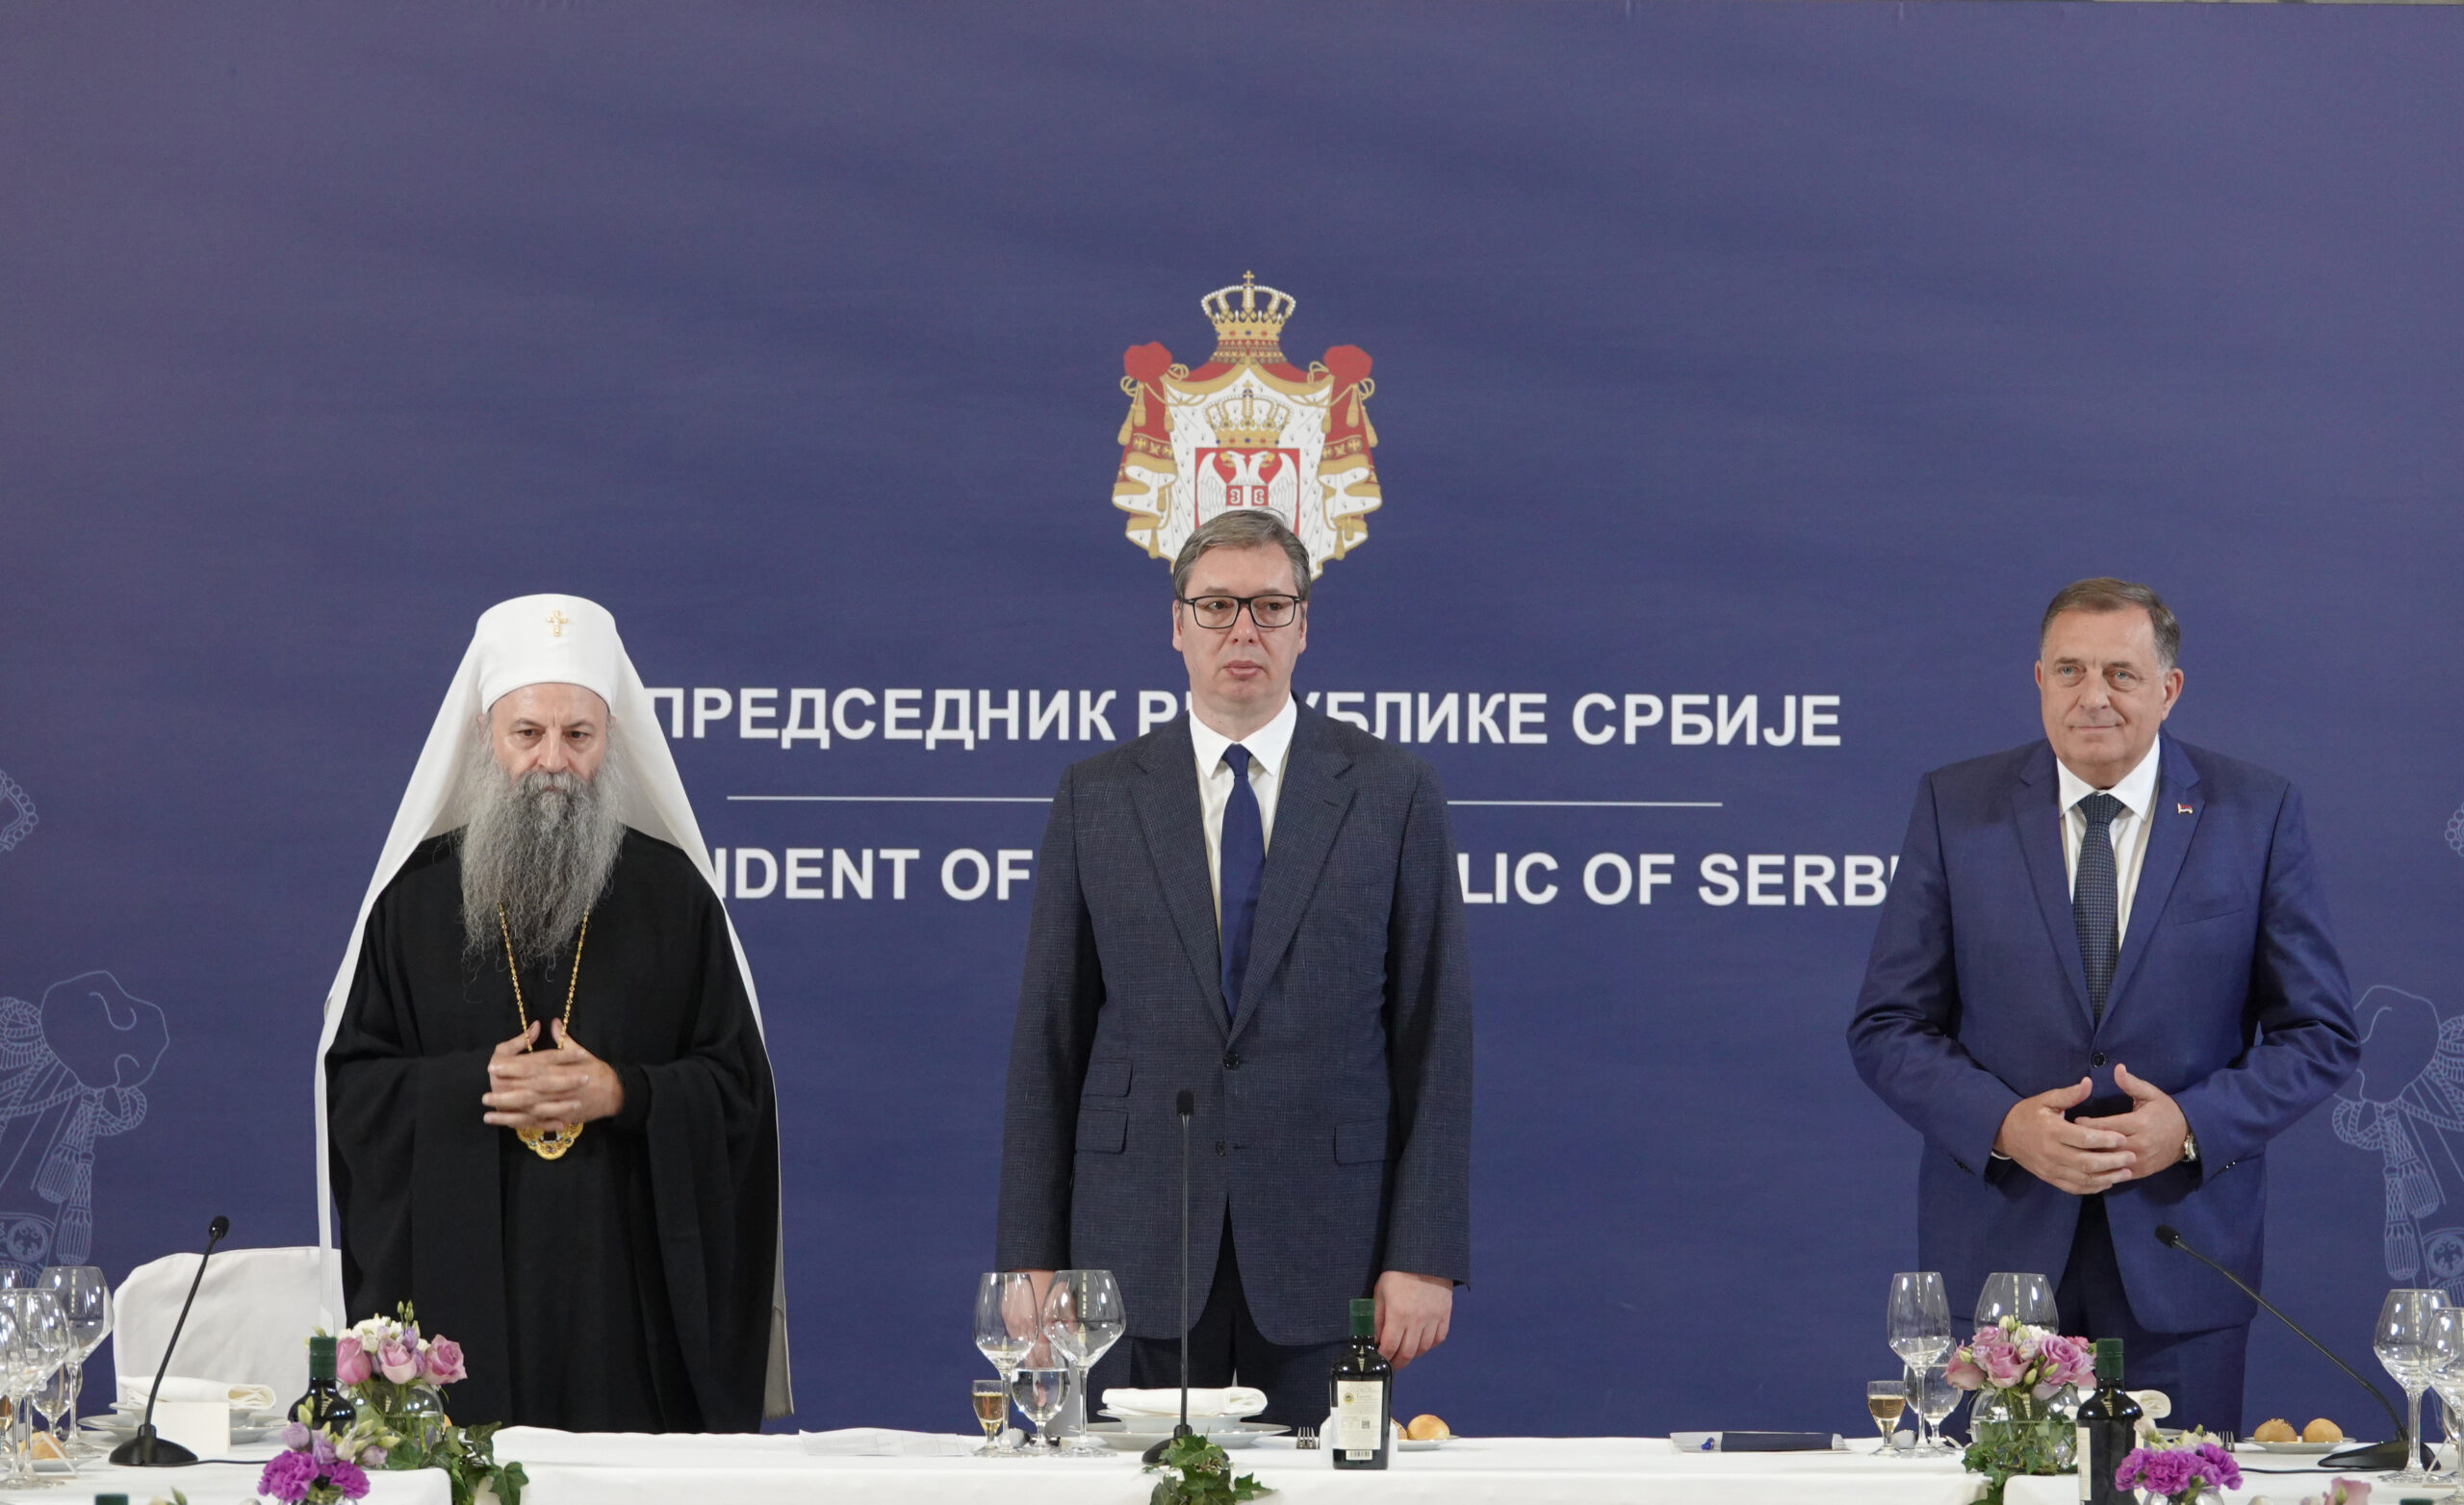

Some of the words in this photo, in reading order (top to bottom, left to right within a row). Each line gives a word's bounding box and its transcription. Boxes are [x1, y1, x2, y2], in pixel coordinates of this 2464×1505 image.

[644, 687, 1116, 750] ПРЕДСЕДНИК
[1572, 692, 1841, 746] СРБИЈЕ
[940, 849, 1034, 901] OF
[1582, 853, 1675, 905] OF
[1698, 854, 1900, 906] SERB
